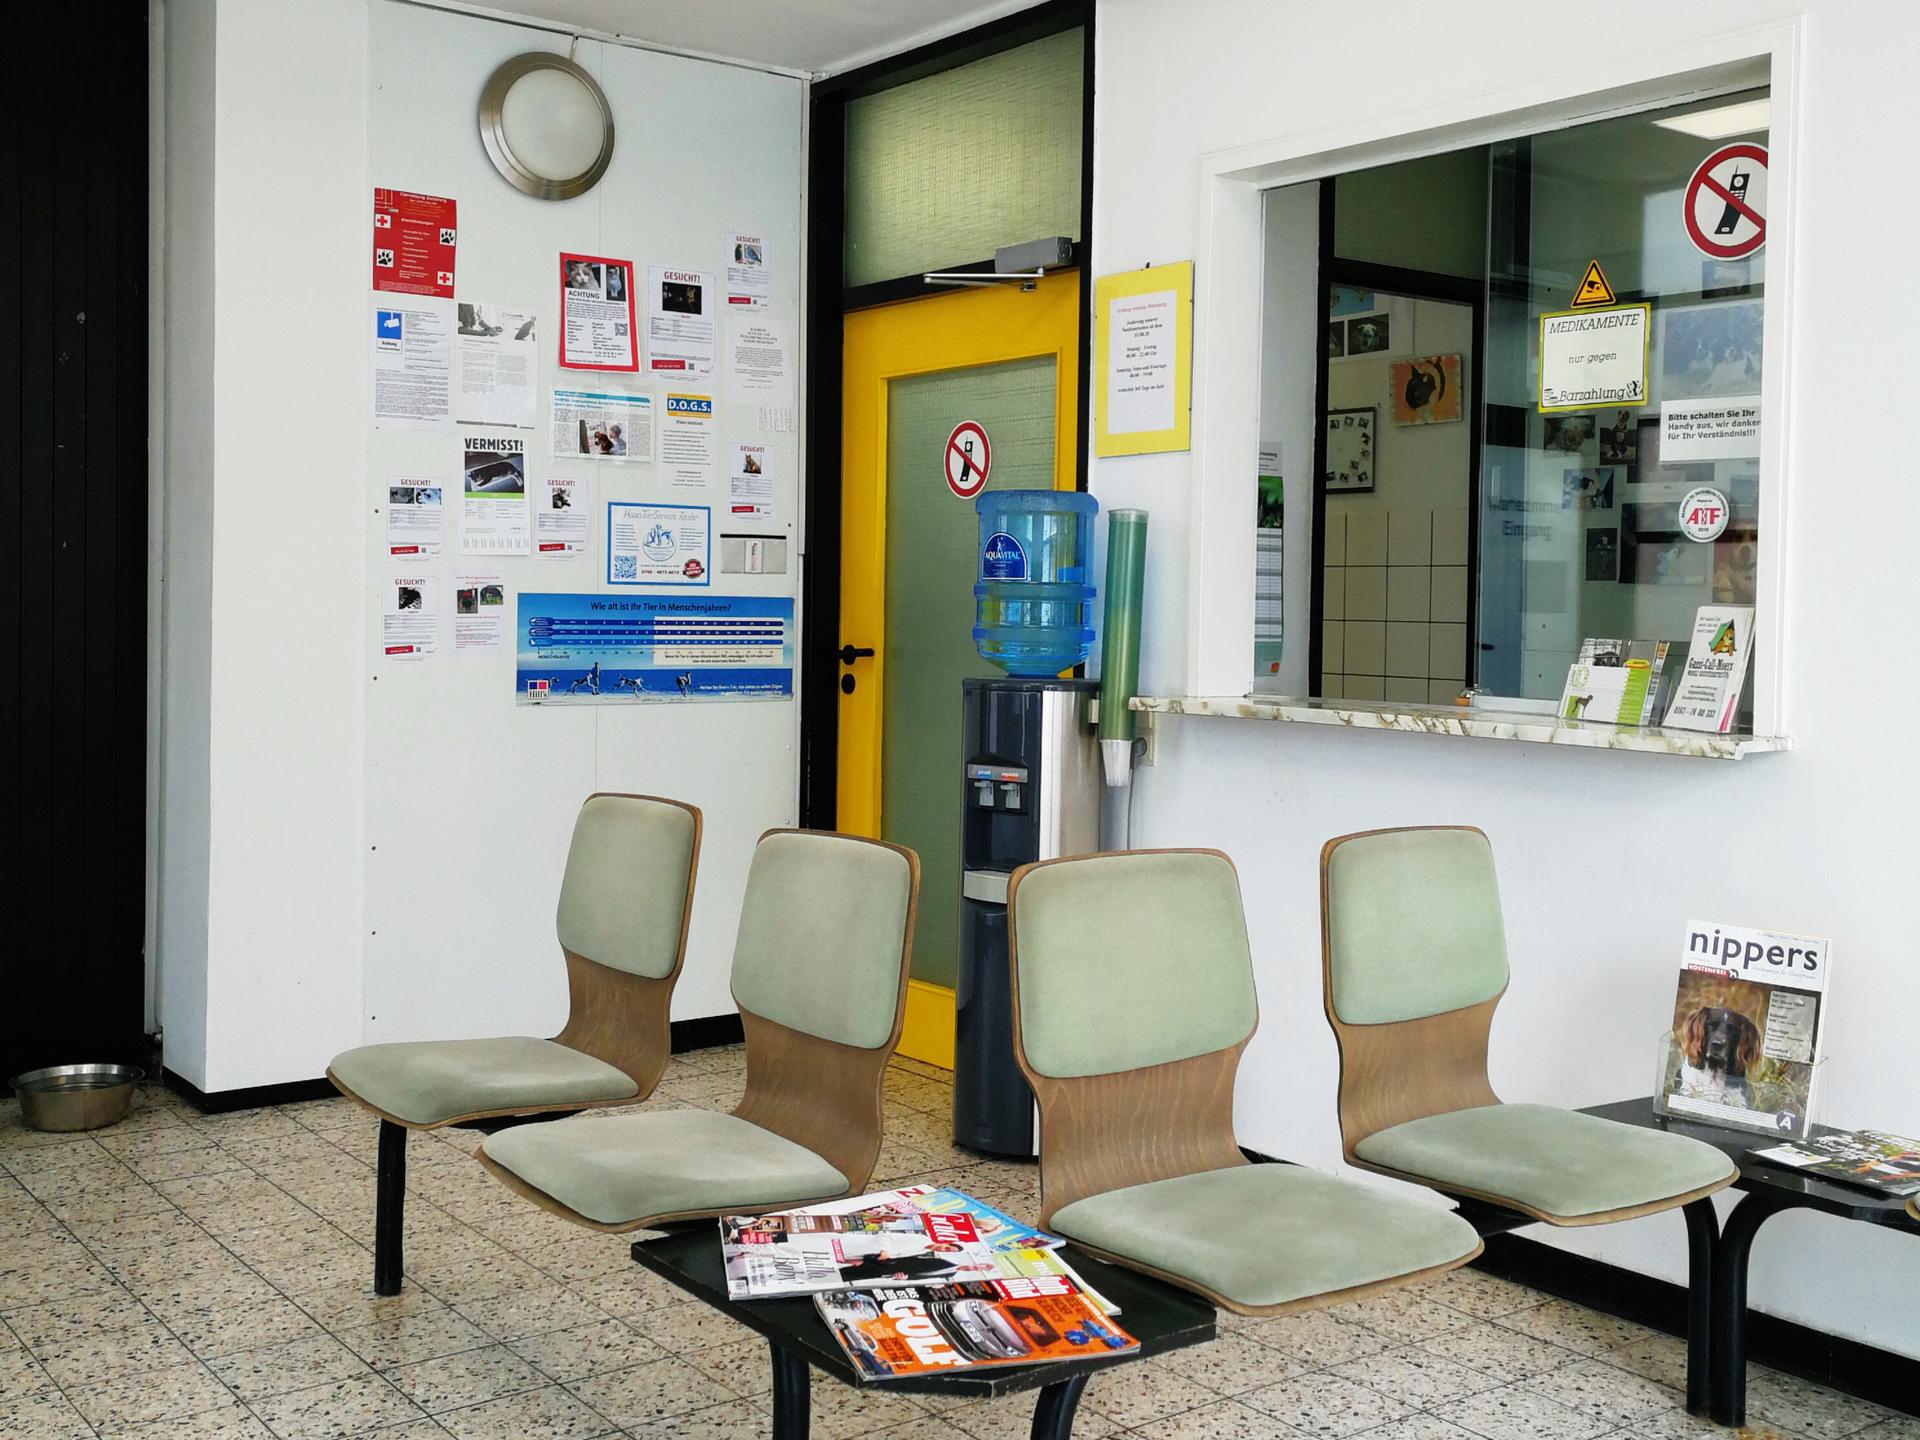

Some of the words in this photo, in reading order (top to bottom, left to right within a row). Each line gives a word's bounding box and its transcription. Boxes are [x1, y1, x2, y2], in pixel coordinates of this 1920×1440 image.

[735, 235, 761, 245] GESUCHT!
[664, 271, 701, 283] GESUCHT!
[568, 290, 600, 299] ACHTUNG
[1549, 313, 1641, 334] MEDIKAMENTE
[1568, 355, 1584, 364] nur
[1587, 352, 1617, 365] gegen
[1560, 387, 1626, 401] Barzahlung
[668, 399, 711, 412] D.O.G.S.
[1668, 413, 1688, 422] Bitte
[1690, 411, 1725, 420] schalten
[1726, 410, 1740, 418] Sie
[1742, 409, 1756, 418] Ihr
[1668, 422, 1695, 431] Handy
[1696, 421, 1714, 430] aus,
[1715, 420, 1730, 429] wir
[1668, 432, 1680, 441] für
[1682, 432, 1696, 440] Ihr
[464, 437, 523, 451] VERMISST!
[740, 444, 765, 453] GESUCHT!
[401, 478, 431, 487] GESUCHT!
[547, 479, 576, 487] GESUCHT!
[394, 578, 425, 586] GESUCHT!
[590, 602, 606, 611] Wie
[607, 602, 618, 611] alt
[620, 602, 629, 611] ist
[630, 603, 640, 611] Ihr
[643, 603, 657, 611] Tier
[668, 604, 732, 614] Menschenjahren?
[1690, 929, 1817, 971] nippers
[1688, 964, 1727, 976] KOSTENFREI
[928, 1212, 970, 1243] Gala
[1000, 1278, 1041, 1299] Bild
[1030, 1275, 1070, 1295] Auto
[883, 1299, 973, 1367] GOLF
